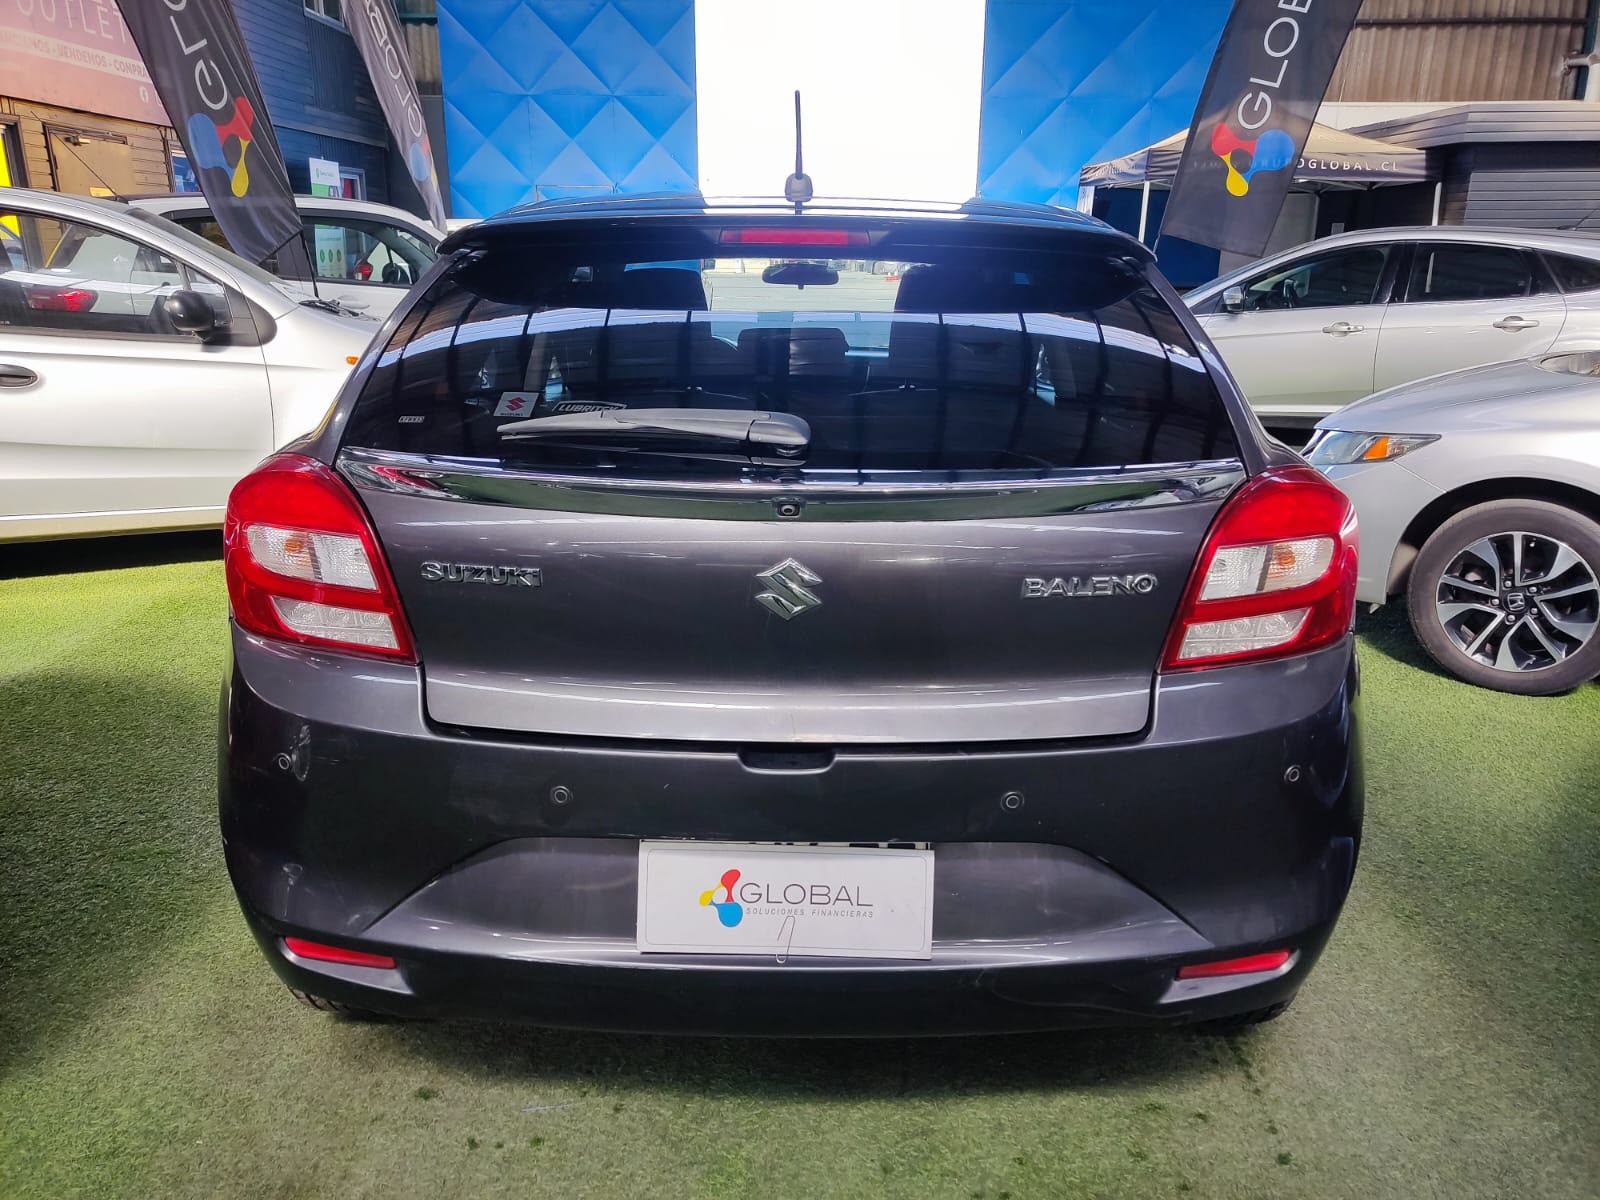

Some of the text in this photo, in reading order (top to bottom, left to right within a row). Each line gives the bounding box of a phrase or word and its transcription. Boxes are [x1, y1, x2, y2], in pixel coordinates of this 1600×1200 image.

[420, 561, 542, 588] SUZUKI
[1022, 573, 1157, 598] BALENO
[740, 882, 873, 907] GLOBAL
[746, 907, 873, 918] SOLUCIONES FINANCIERAS
